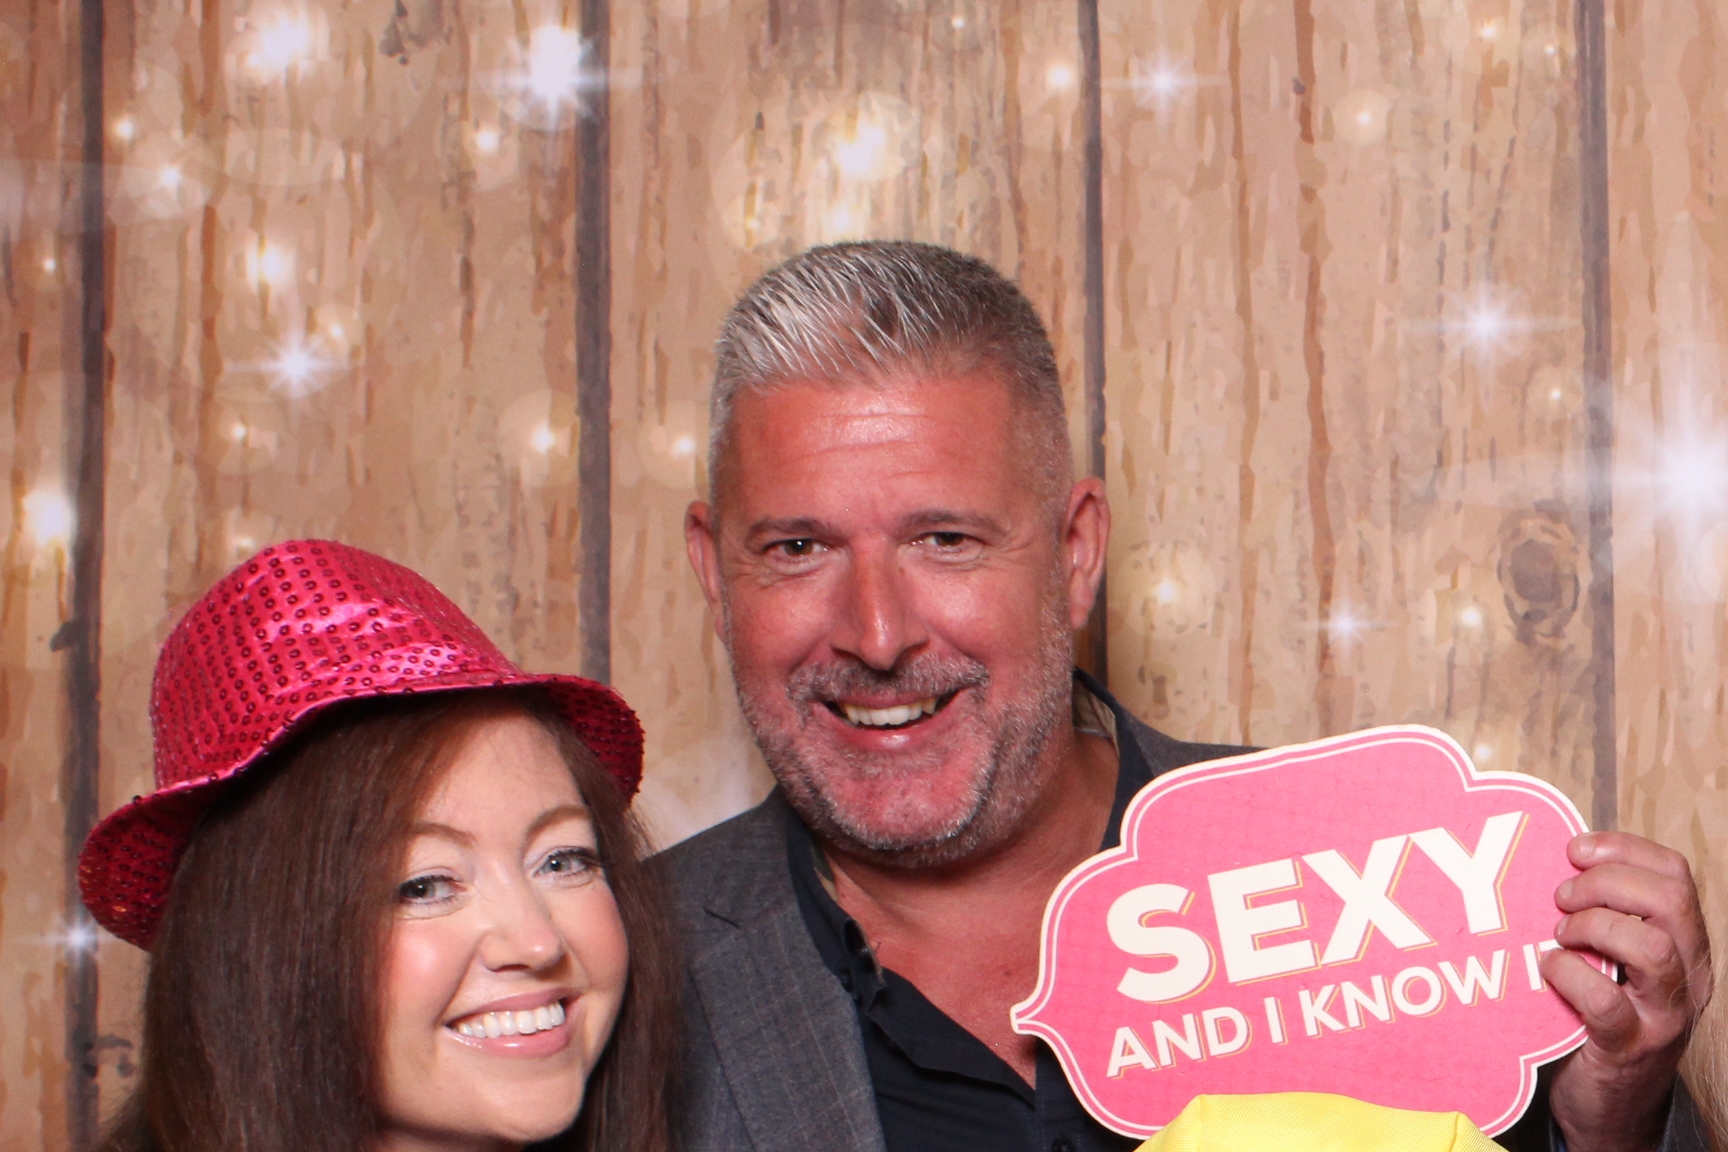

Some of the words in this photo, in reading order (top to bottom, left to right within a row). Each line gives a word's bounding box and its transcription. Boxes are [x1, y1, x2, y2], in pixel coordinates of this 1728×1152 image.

[1107, 811, 1528, 1003] SEXY
[1107, 1007, 1250, 1077] AND
[1264, 997, 1287, 1045] I
[1299, 950, 1509, 1038] KNOW
[1523, 939, 1564, 992] I
